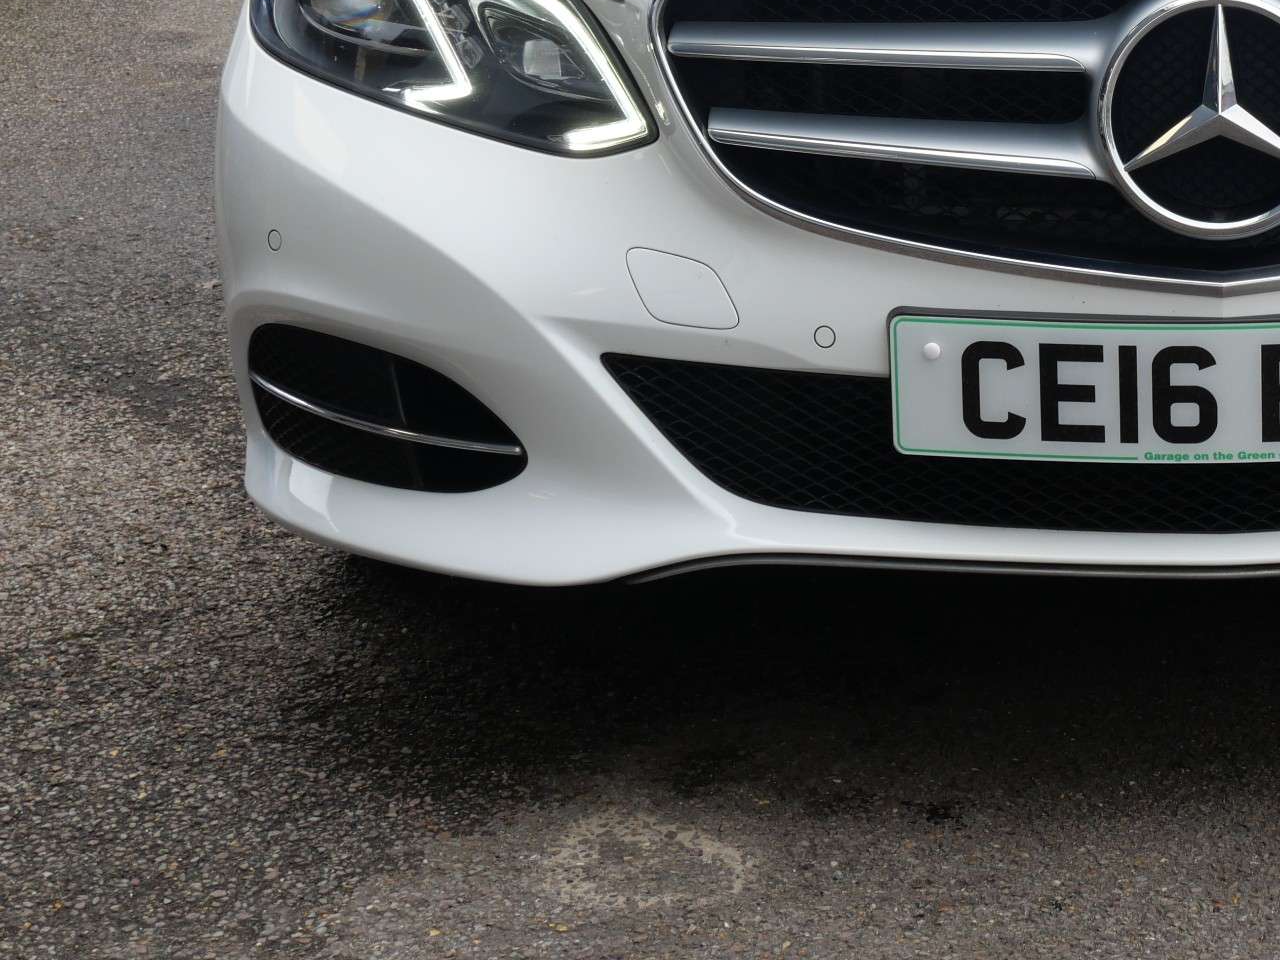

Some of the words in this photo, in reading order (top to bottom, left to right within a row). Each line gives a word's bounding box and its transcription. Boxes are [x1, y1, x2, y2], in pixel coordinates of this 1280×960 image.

[961, 341, 1218, 444] CE16
[1144, 451, 1190, 461] Garage
[1193, 453, 1209, 461] on
[1213, 451, 1234, 461] the
[1238, 451, 1275, 460] Green
